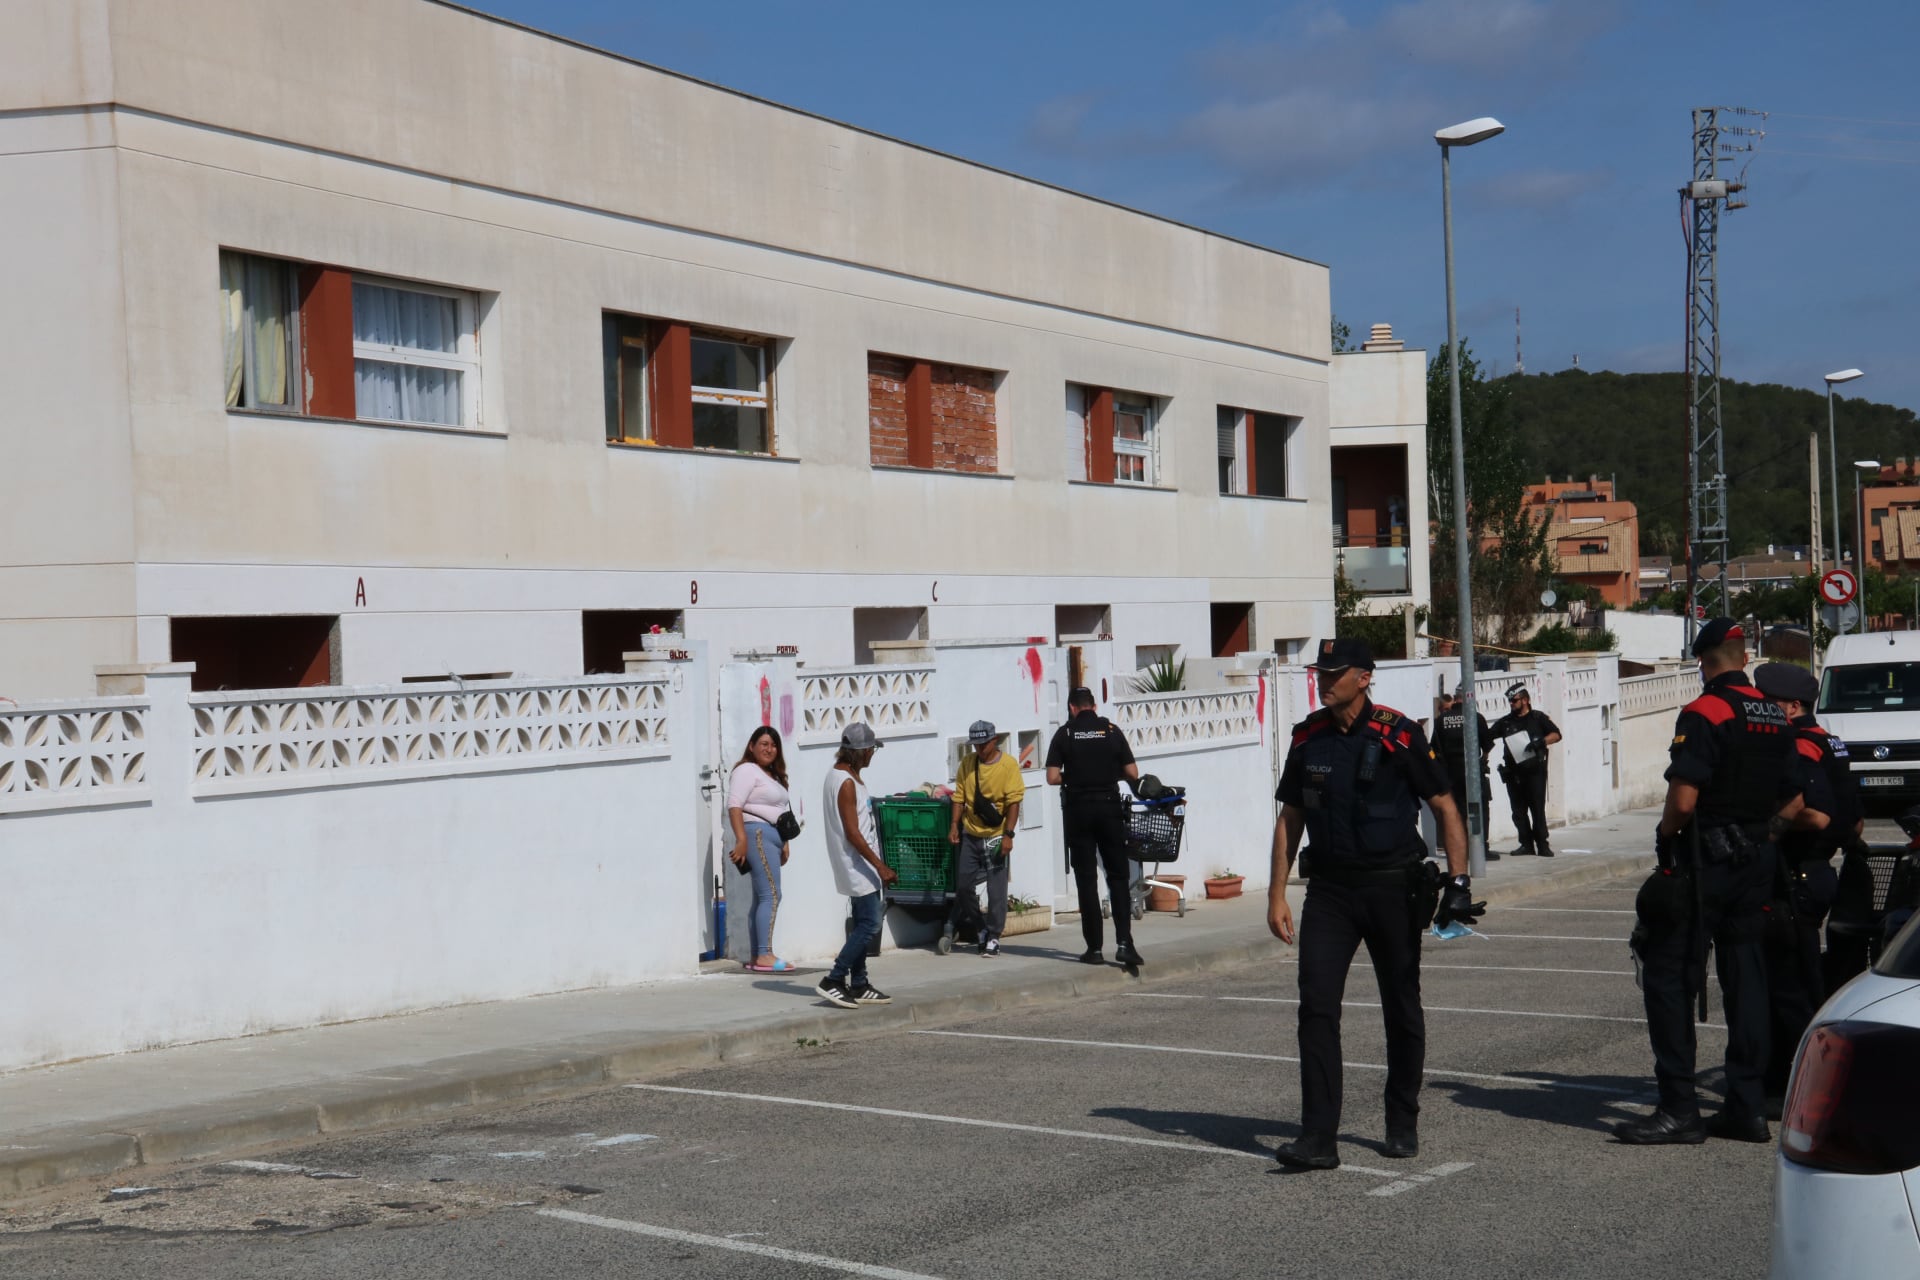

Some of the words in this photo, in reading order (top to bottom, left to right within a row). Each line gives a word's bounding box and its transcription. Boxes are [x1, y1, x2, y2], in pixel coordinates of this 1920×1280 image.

[355, 576, 366, 607] A
[690, 580, 698, 604] B
[669, 649, 688, 659] BLOC
[776, 645, 799, 654] PORTAL
[1742, 701, 1786, 717] POLICIA
